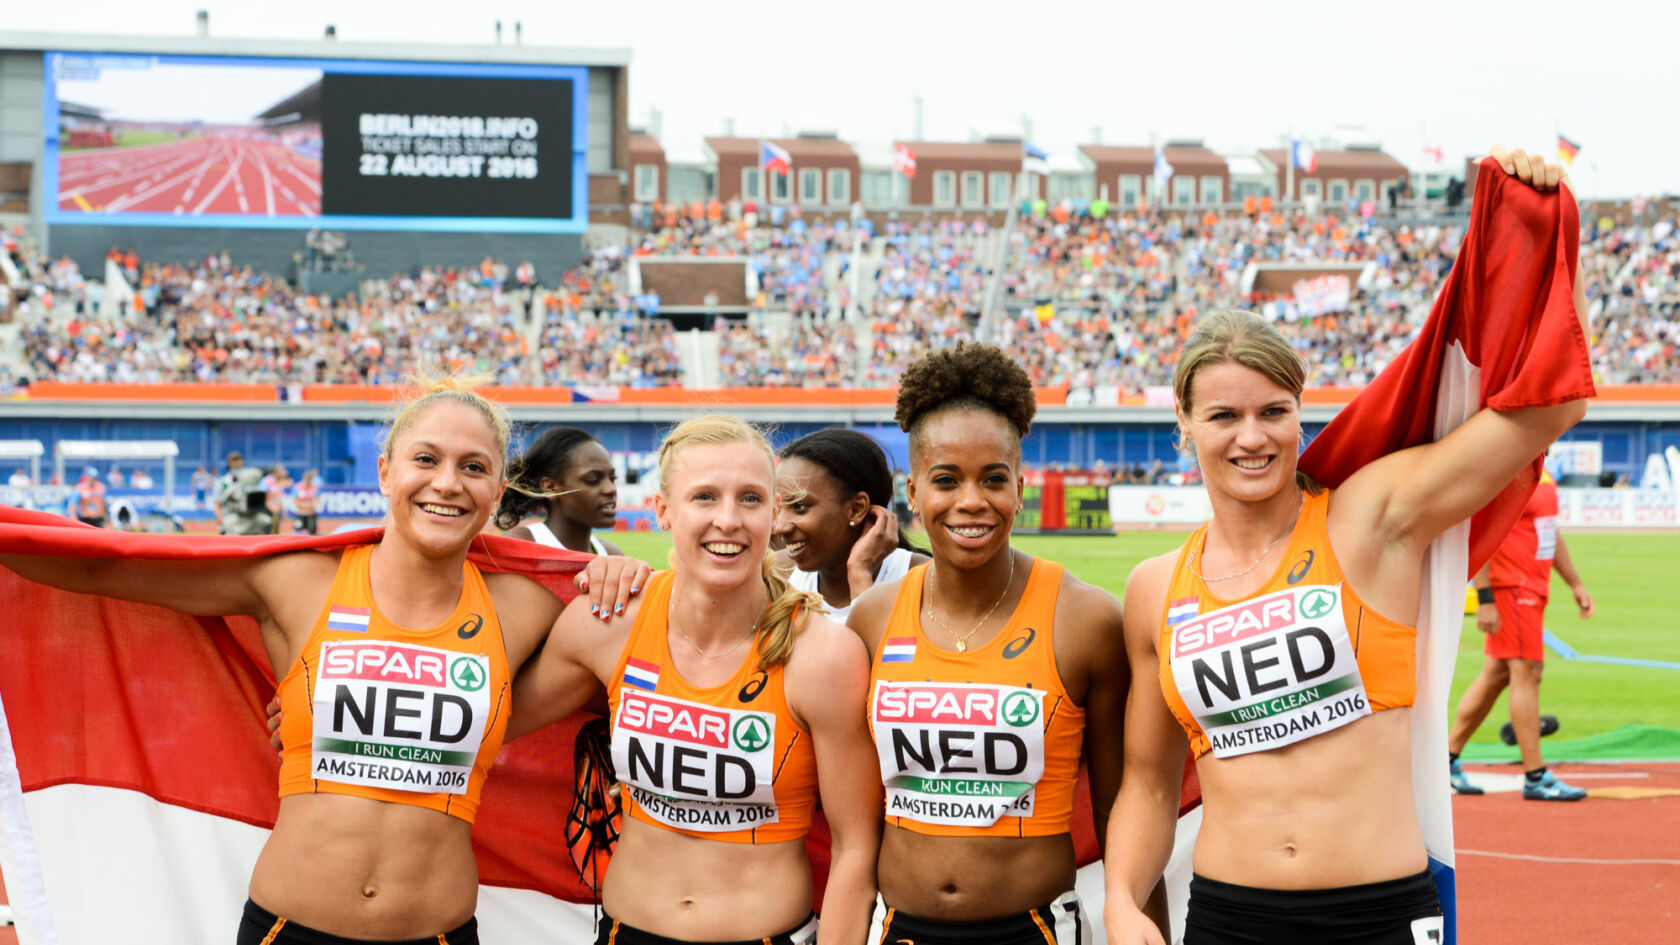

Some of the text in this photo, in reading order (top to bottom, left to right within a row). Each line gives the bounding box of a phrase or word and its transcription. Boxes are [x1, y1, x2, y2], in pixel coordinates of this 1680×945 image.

[359, 113, 538, 139] BERLIN2018.INFO
[361, 137, 538, 156] TICKET SALES START ON
[359, 153, 388, 176] 22
[390, 153, 485, 177] AUGUST
[1178, 598, 1291, 652] SPAR
[326, 649, 443, 682] SPAR
[1192, 626, 1335, 708] NED
[333, 684, 473, 744] NED
[622, 699, 726, 743] SPAR
[879, 690, 995, 720] SPAR
[1213, 693, 1365, 750] AMSTERDAM 2016
[1231, 688, 1320, 723] I RUN CLEAN
[355, 743, 442, 763] I RUN CLEAN
[628, 736, 755, 798] NED
[891, 728, 1028, 775] NED
[317, 758, 466, 787] AMSTERDAM 2016
[955, 781, 1003, 795] CLEAN
[632, 788, 731, 825] AMSTERDAM
[736, 805, 775, 824] 2016
[891, 795, 995, 819] AMSTERDAM
